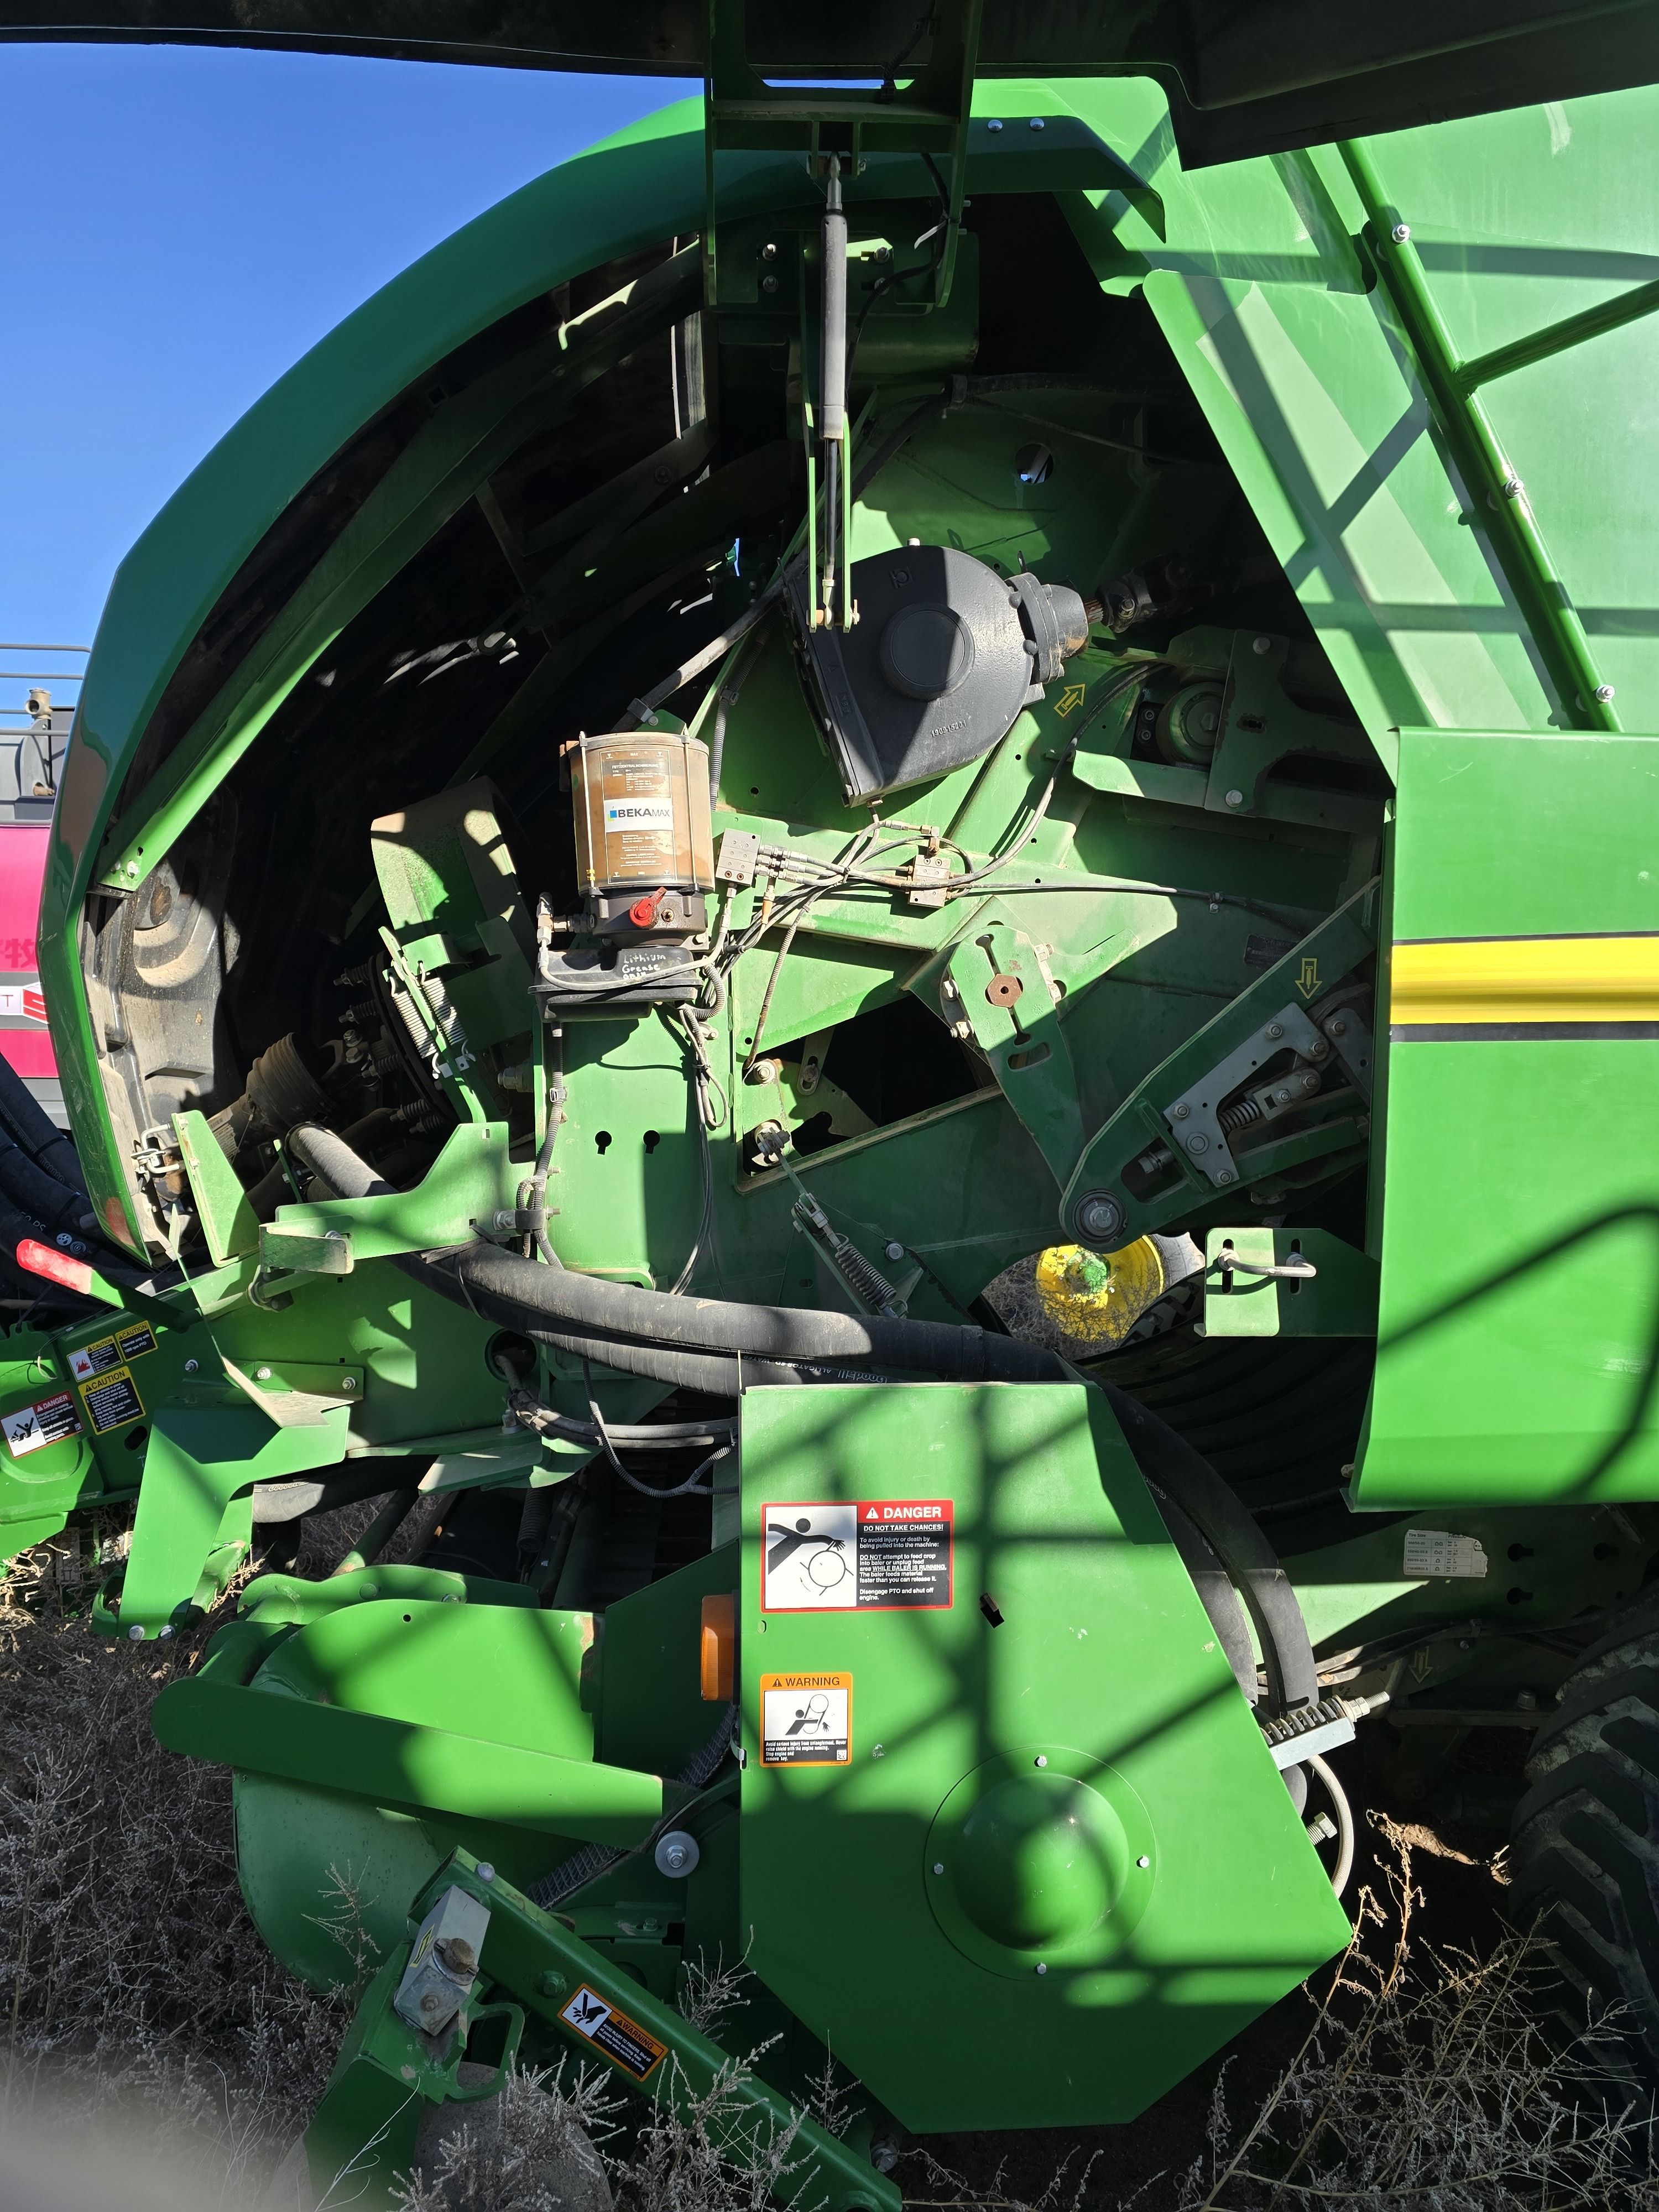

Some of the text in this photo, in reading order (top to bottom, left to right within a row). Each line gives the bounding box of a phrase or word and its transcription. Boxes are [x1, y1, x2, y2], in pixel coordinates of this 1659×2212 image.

[618, 808, 670, 818] BEKAMAX
[624, 953, 666, 963] Lithium
[622, 964, 660, 973] Grease
[122, 1324, 147, 1338] CAUTION
[92, 1338, 113, 1349] CAUTION
[91, 1370, 126, 1390] CAUTION
[43, 1395, 68, 1410] DANGER
[884, 1506, 941, 1519] DANGER
[785, 1677, 839, 1686] WARNING
[603, 2023, 613, 2032] AVOID
[622, 2022, 654, 2050] WARNING
